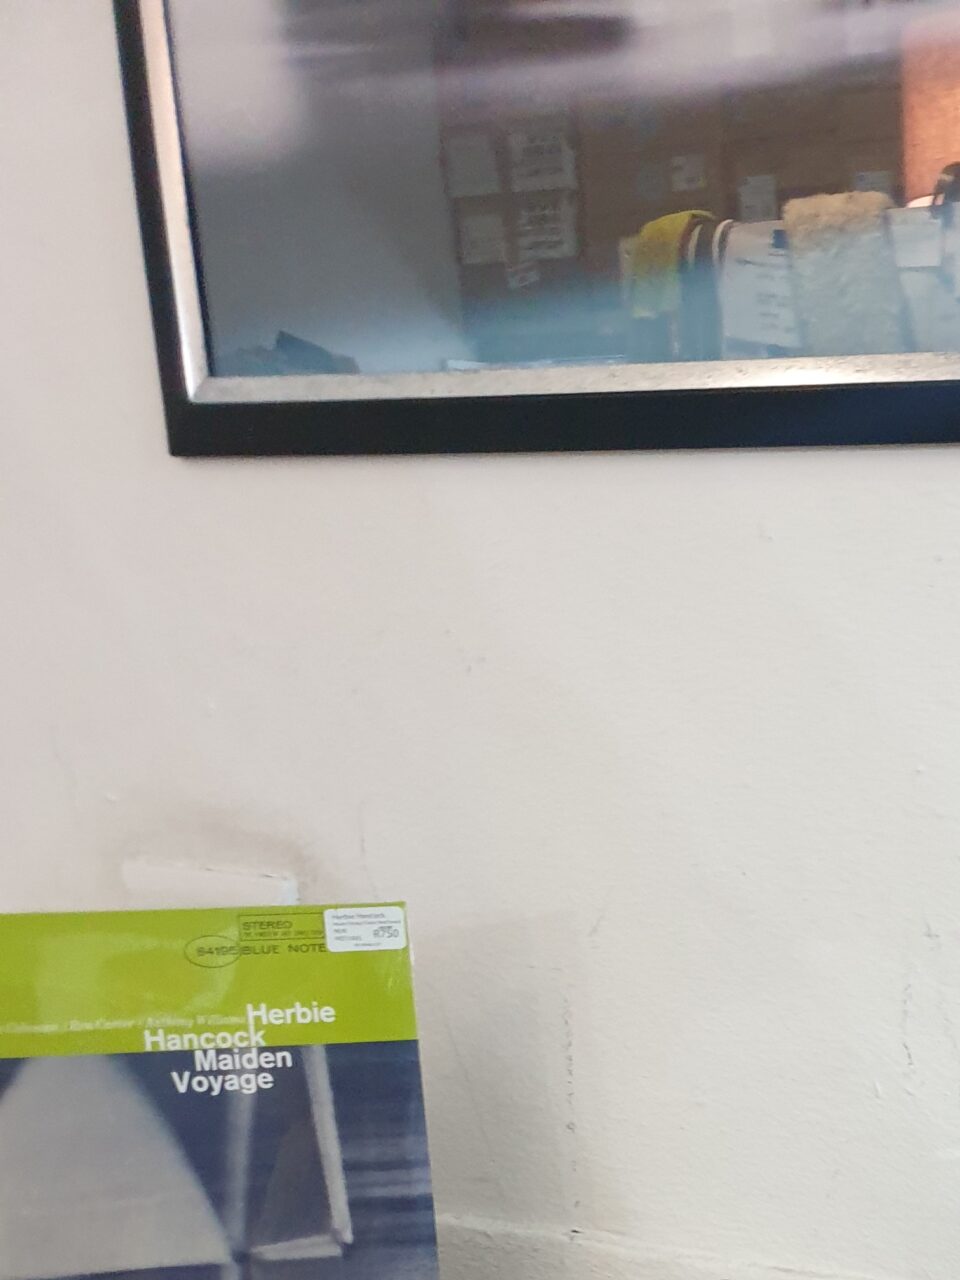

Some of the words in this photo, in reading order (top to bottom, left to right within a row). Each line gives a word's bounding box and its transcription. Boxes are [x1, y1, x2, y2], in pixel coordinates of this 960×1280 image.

[242, 920, 293, 931] STEREO
[240, 944, 280, 956] BLUE
[288, 943, 328, 953] NOTE
[246, 1002, 336, 1026] Herbie
[144, 1022, 266, 1051] Hancock
[194, 1048, 293, 1072] Maiden
[171, 1070, 274, 1096] Voyage
